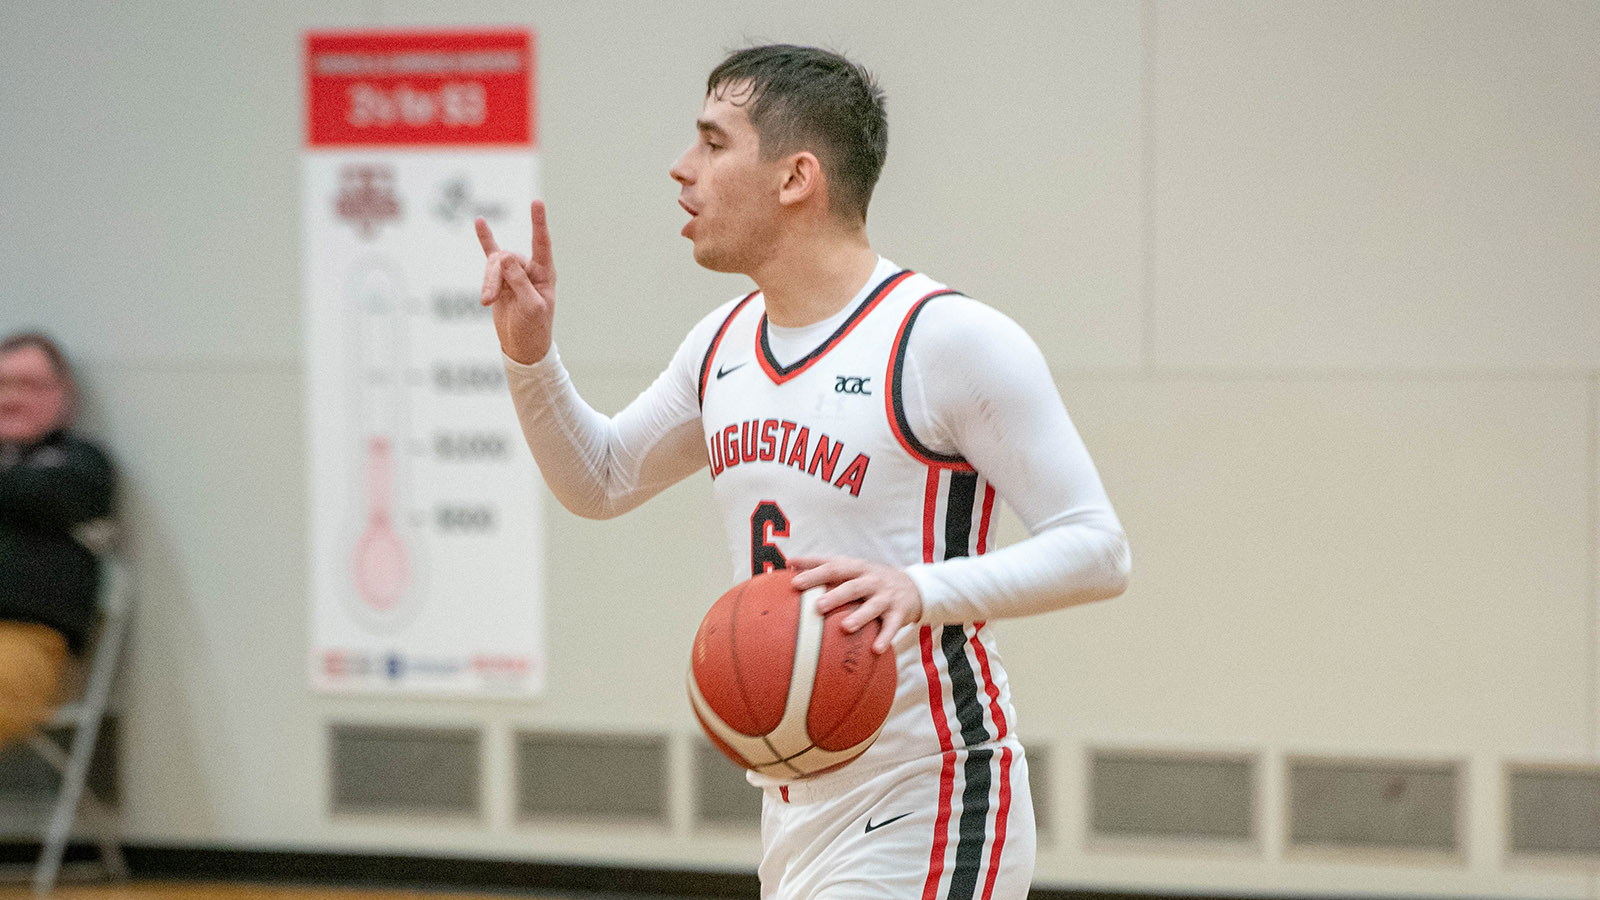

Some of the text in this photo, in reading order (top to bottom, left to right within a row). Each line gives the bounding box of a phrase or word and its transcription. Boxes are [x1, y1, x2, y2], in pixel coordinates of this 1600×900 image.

[835, 376, 872, 395] acac
[708, 418, 870, 497] UGUSTANA
[750, 500, 790, 579] 6
